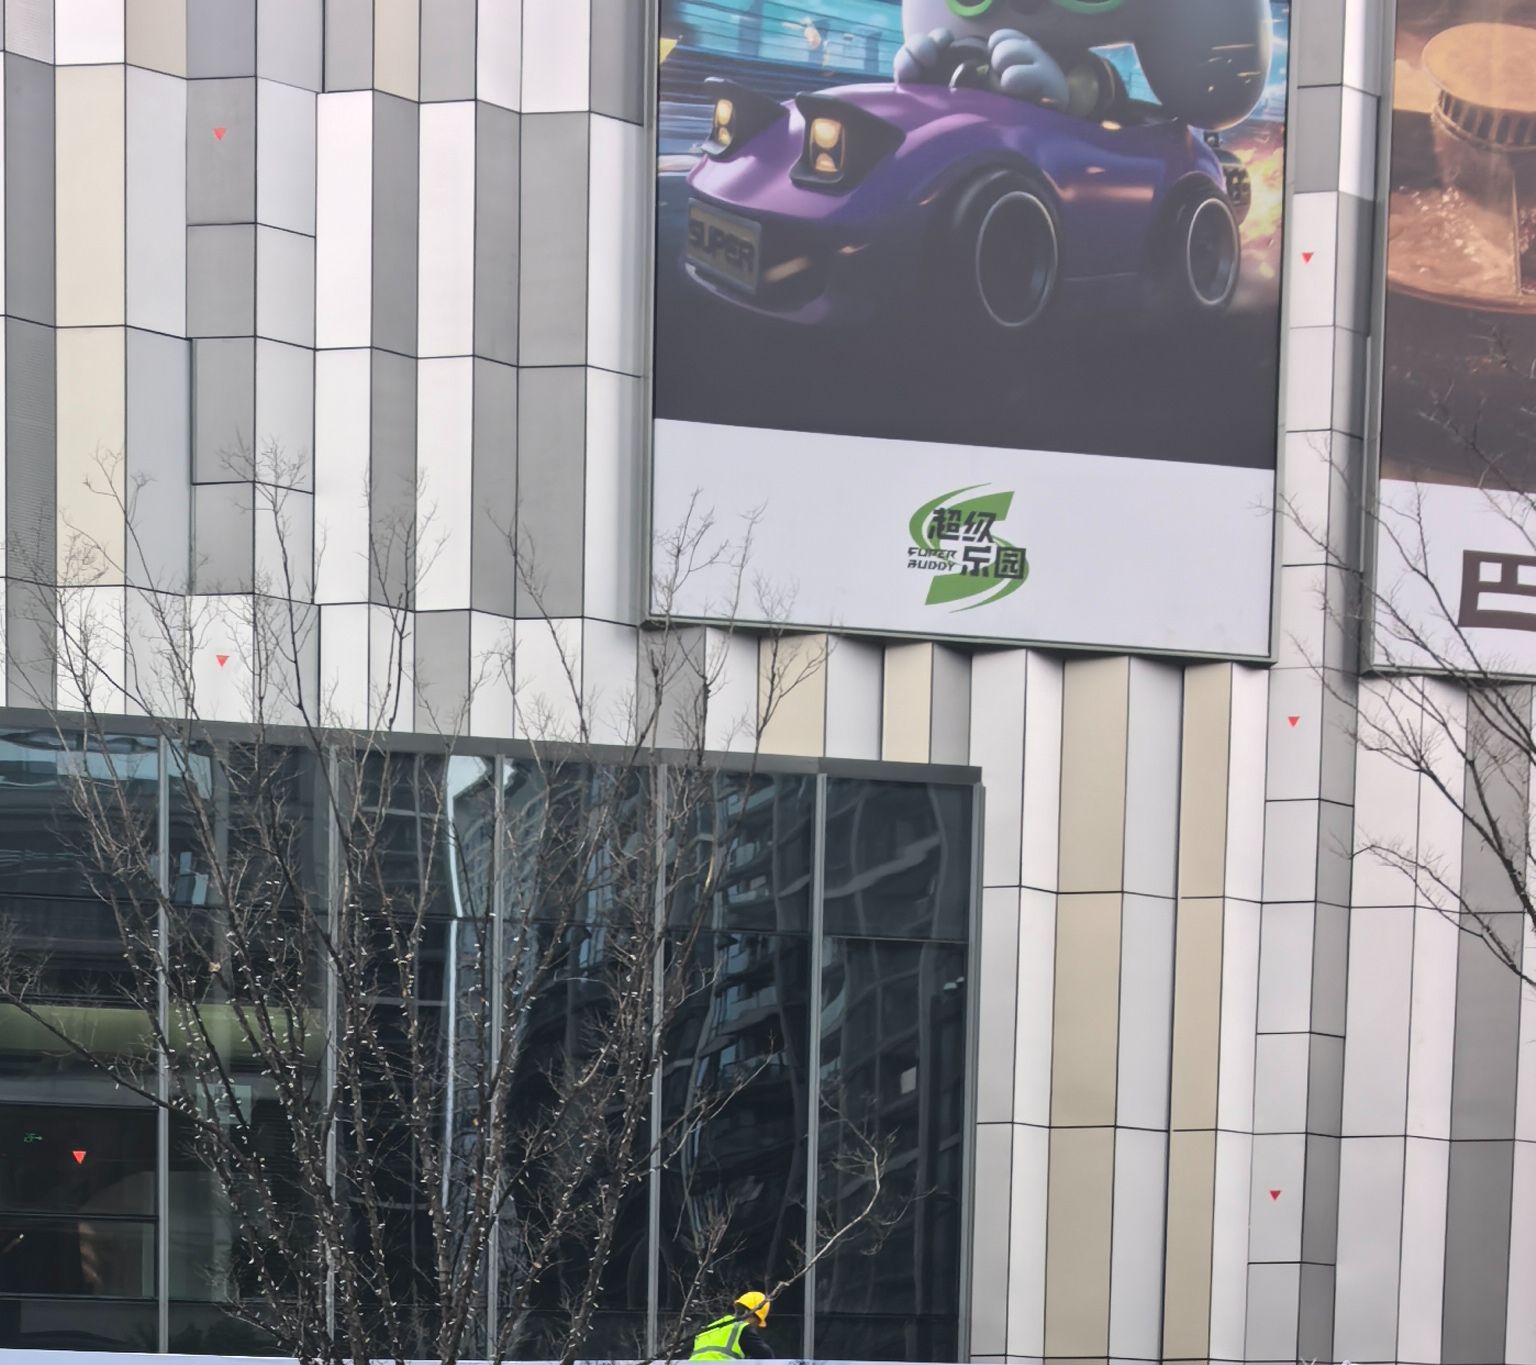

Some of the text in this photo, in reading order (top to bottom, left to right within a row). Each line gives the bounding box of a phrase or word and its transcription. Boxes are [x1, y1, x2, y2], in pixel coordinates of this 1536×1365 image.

[927, 507, 997, 543] 超级
[906, 559, 956, 571] BUDDY
[960, 545, 1027, 580] 乐园
